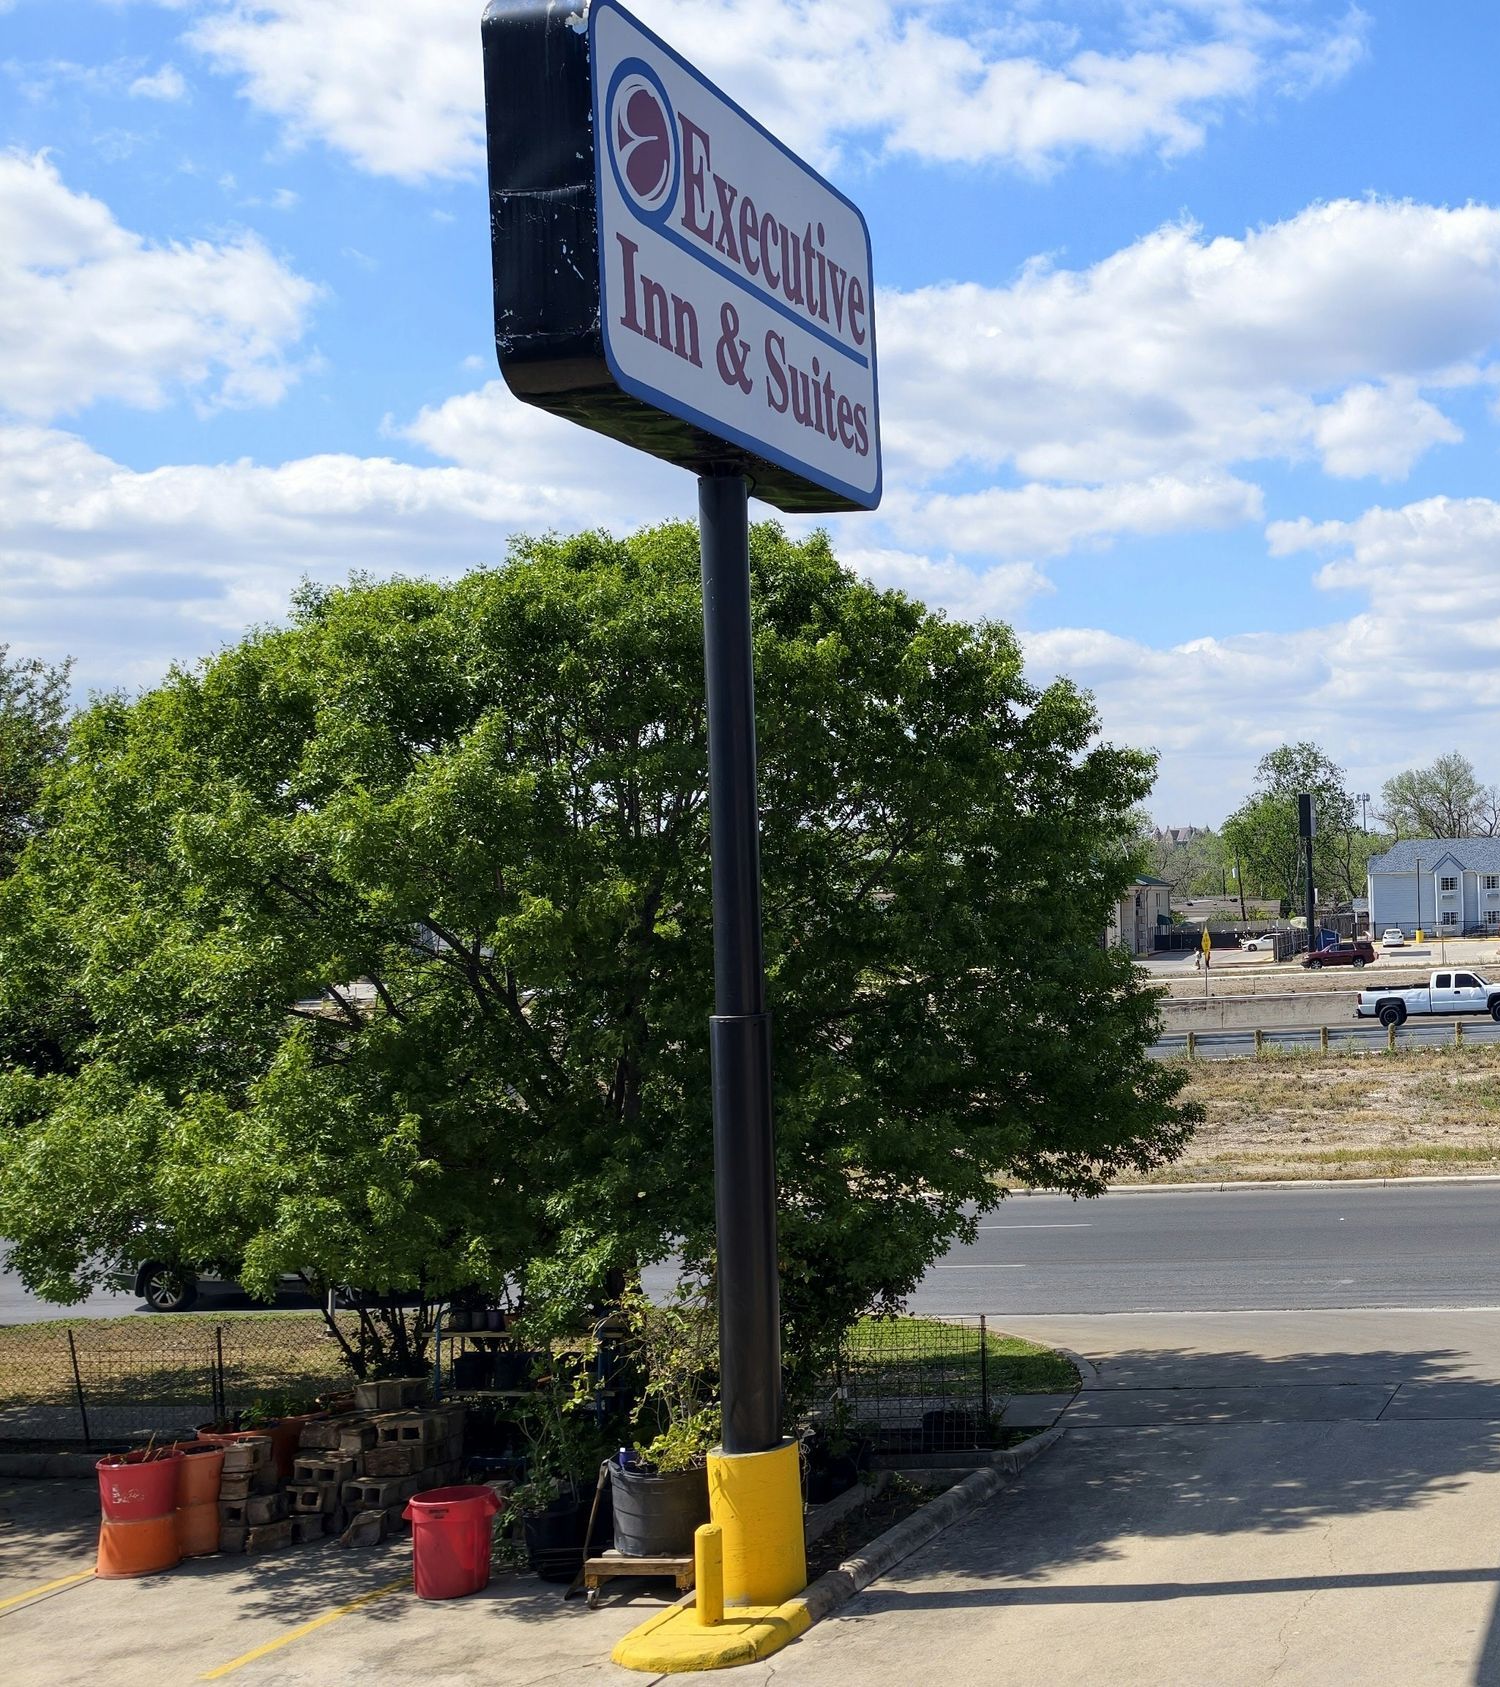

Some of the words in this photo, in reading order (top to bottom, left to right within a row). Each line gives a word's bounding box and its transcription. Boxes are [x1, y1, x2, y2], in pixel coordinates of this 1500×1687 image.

[678, 113, 865, 346] Executive
[616, 232, 703, 369] Inn
[716, 301, 753, 395] &
[765, 329, 869, 457] Suites
